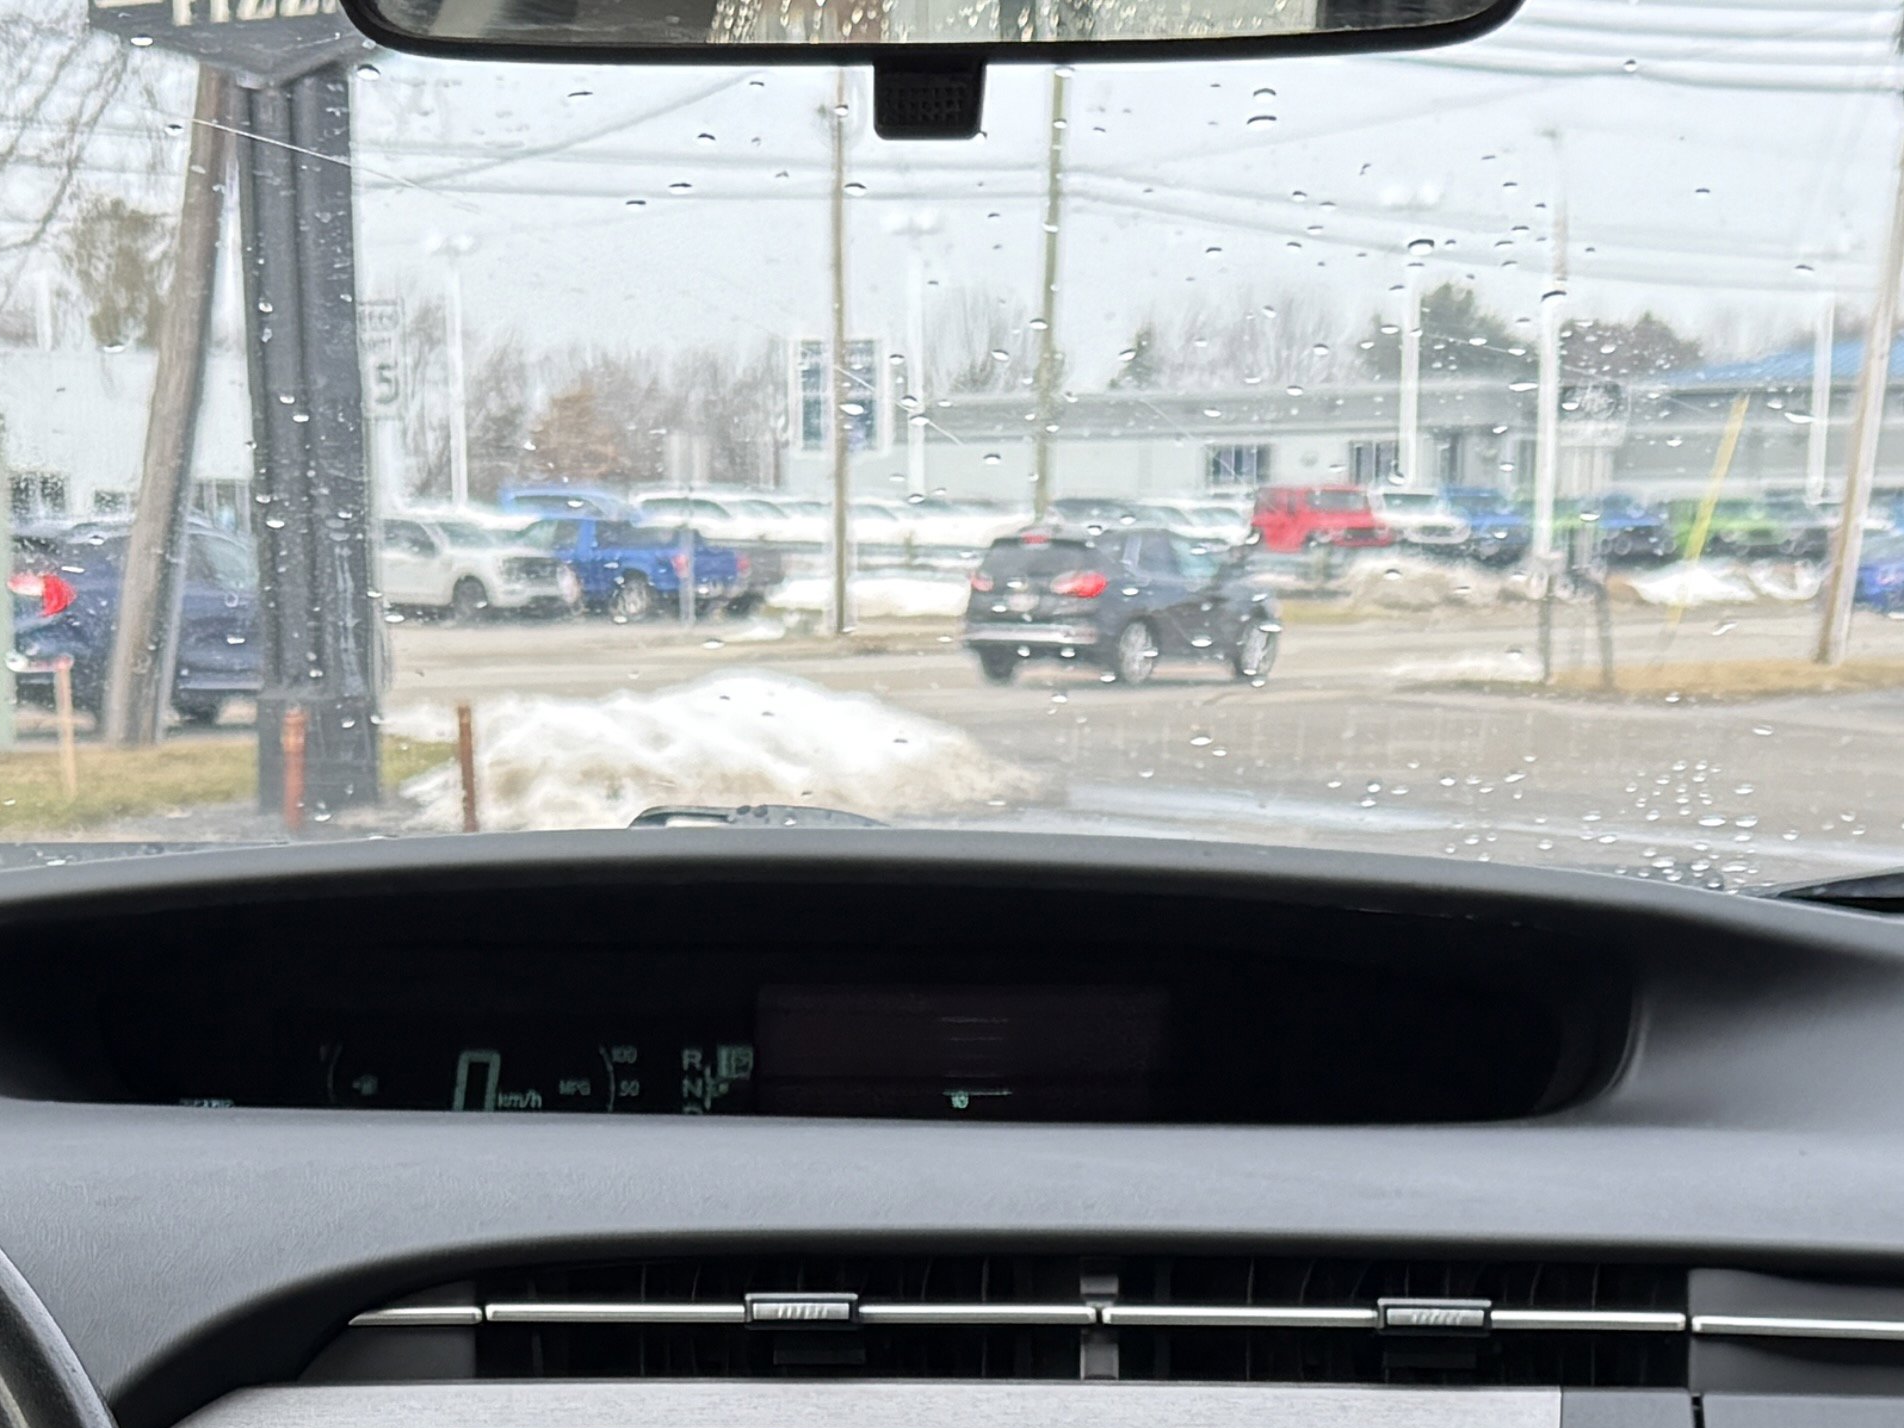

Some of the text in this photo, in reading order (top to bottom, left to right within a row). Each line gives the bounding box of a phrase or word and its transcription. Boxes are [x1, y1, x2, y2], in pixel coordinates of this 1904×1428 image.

[682, 1048, 703, 1071] R
[498, 1089, 543, 1109] km/h
[682, 1077, 703, 1099] N
